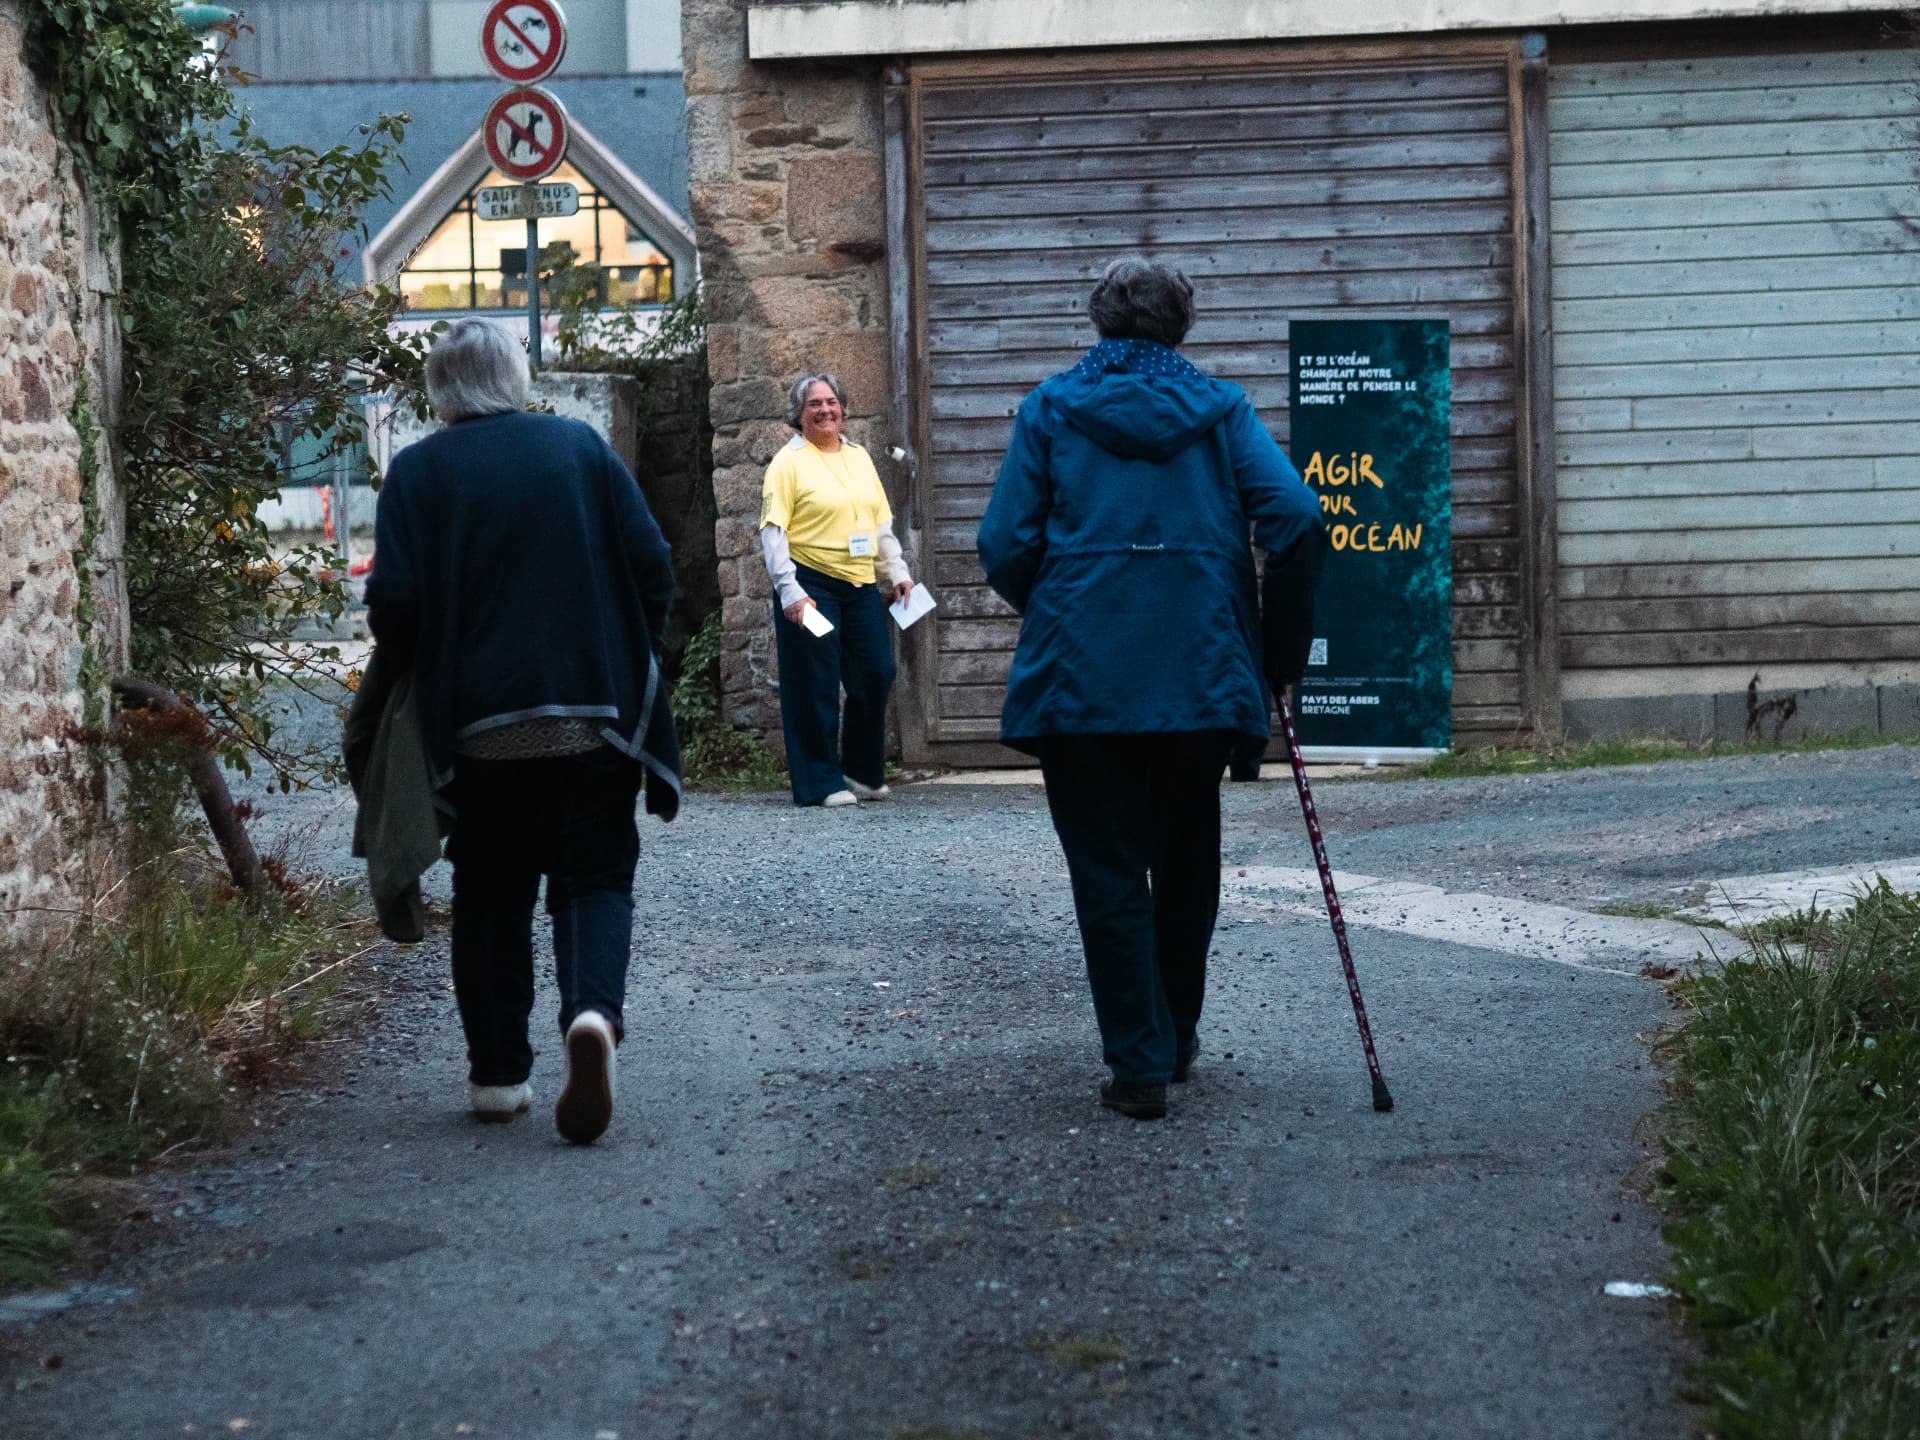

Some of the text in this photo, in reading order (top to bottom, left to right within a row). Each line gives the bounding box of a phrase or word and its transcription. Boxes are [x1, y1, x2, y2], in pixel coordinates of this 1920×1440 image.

[481, 186, 571, 203] SAUF ENUS
[491, 201, 563, 216] EN LSSE
[1299, 350, 1371, 366] ET SI L'OCÉAN
[1299, 368, 1392, 379] CHANGEAIT NOTRE
[1300, 378, 1417, 392] MANIÈRE DE PENSER LE
[1300, 394, 1346, 405] MONDE ?
[1318, 494, 1358, 516] OUR
[1325, 521, 1422, 552] 'OCÉAN
[1301, 695, 1380, 705] PAYS DES ABERS
[1301, 705, 1351, 715] BRETAGNE
